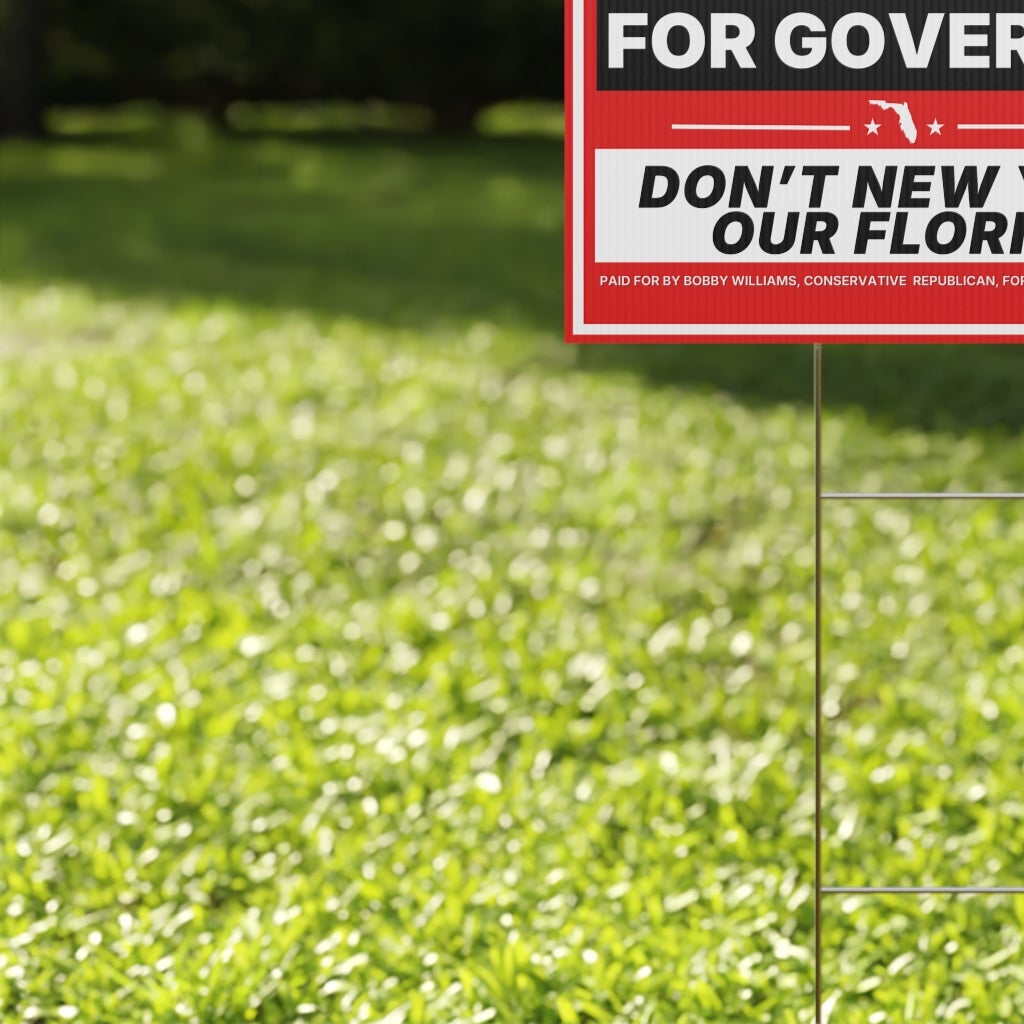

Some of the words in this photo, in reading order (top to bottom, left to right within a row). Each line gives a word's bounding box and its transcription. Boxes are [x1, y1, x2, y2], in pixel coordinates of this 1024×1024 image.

[608, 11, 757, 70] FOR
[638, 164, 839, 209] DON’T
[852, 165, 1001, 209] NEW
[712, 211, 839, 255] OUR
[599, 275, 630, 286] PAID
[634, 275, 659, 286] FOR
[663, 275, 681, 286] BY
[683, 275, 728, 286] BOBBY
[731, 275, 801, 289] WILLIAMS,
[803, 275, 907, 286] CONSERVATIVE
[912, 275, 999, 289] REPUBLICAN,
